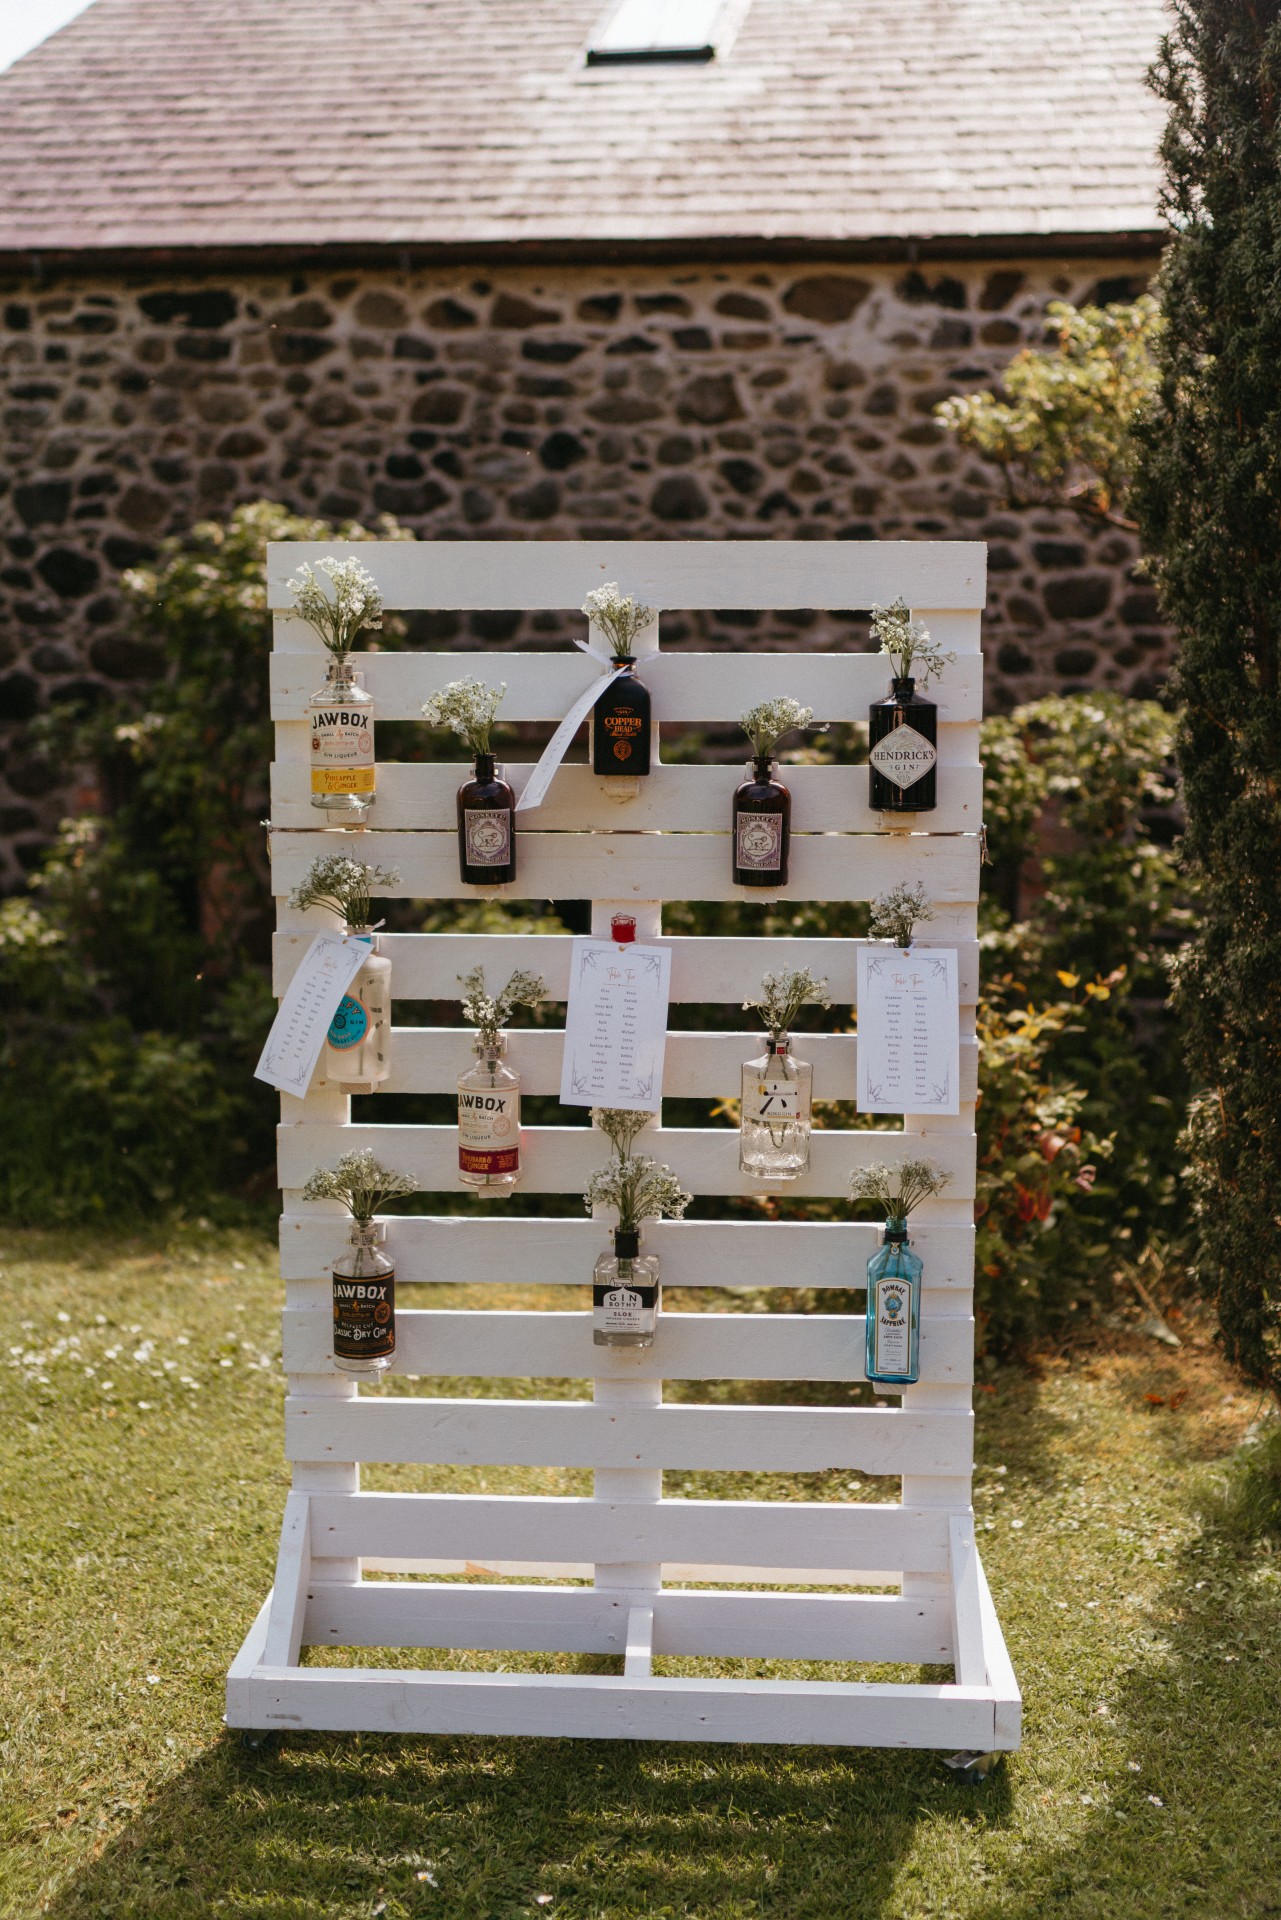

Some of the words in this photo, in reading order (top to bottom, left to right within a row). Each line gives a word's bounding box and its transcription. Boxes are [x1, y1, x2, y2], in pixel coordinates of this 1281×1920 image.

[312, 712, 369, 730] JAWBOX
[604, 717, 642, 727] COPPER
[614, 725, 633, 733] HEAD
[334, 751, 358, 760] LIQUEUR
[874, 750, 934, 761] HENDRICK'S
[324, 773, 357, 785] PINEAPPLE
[469, 812, 499, 821] MONKEY
[740, 815, 770, 824] MONKEY
[458, 1094, 506, 1113] AWBOX
[333, 1284, 387, 1300] JAWBOX
[881, 1284, 906, 1295] BOMBAY
[608, 1293, 638, 1302] GIN
[341, 1321, 362, 1329] BELFAST
[880, 1315, 907, 1327] SAPPHIRE
[353, 1328, 372, 1340] DRY
[373, 1327, 388, 1338] GIN
